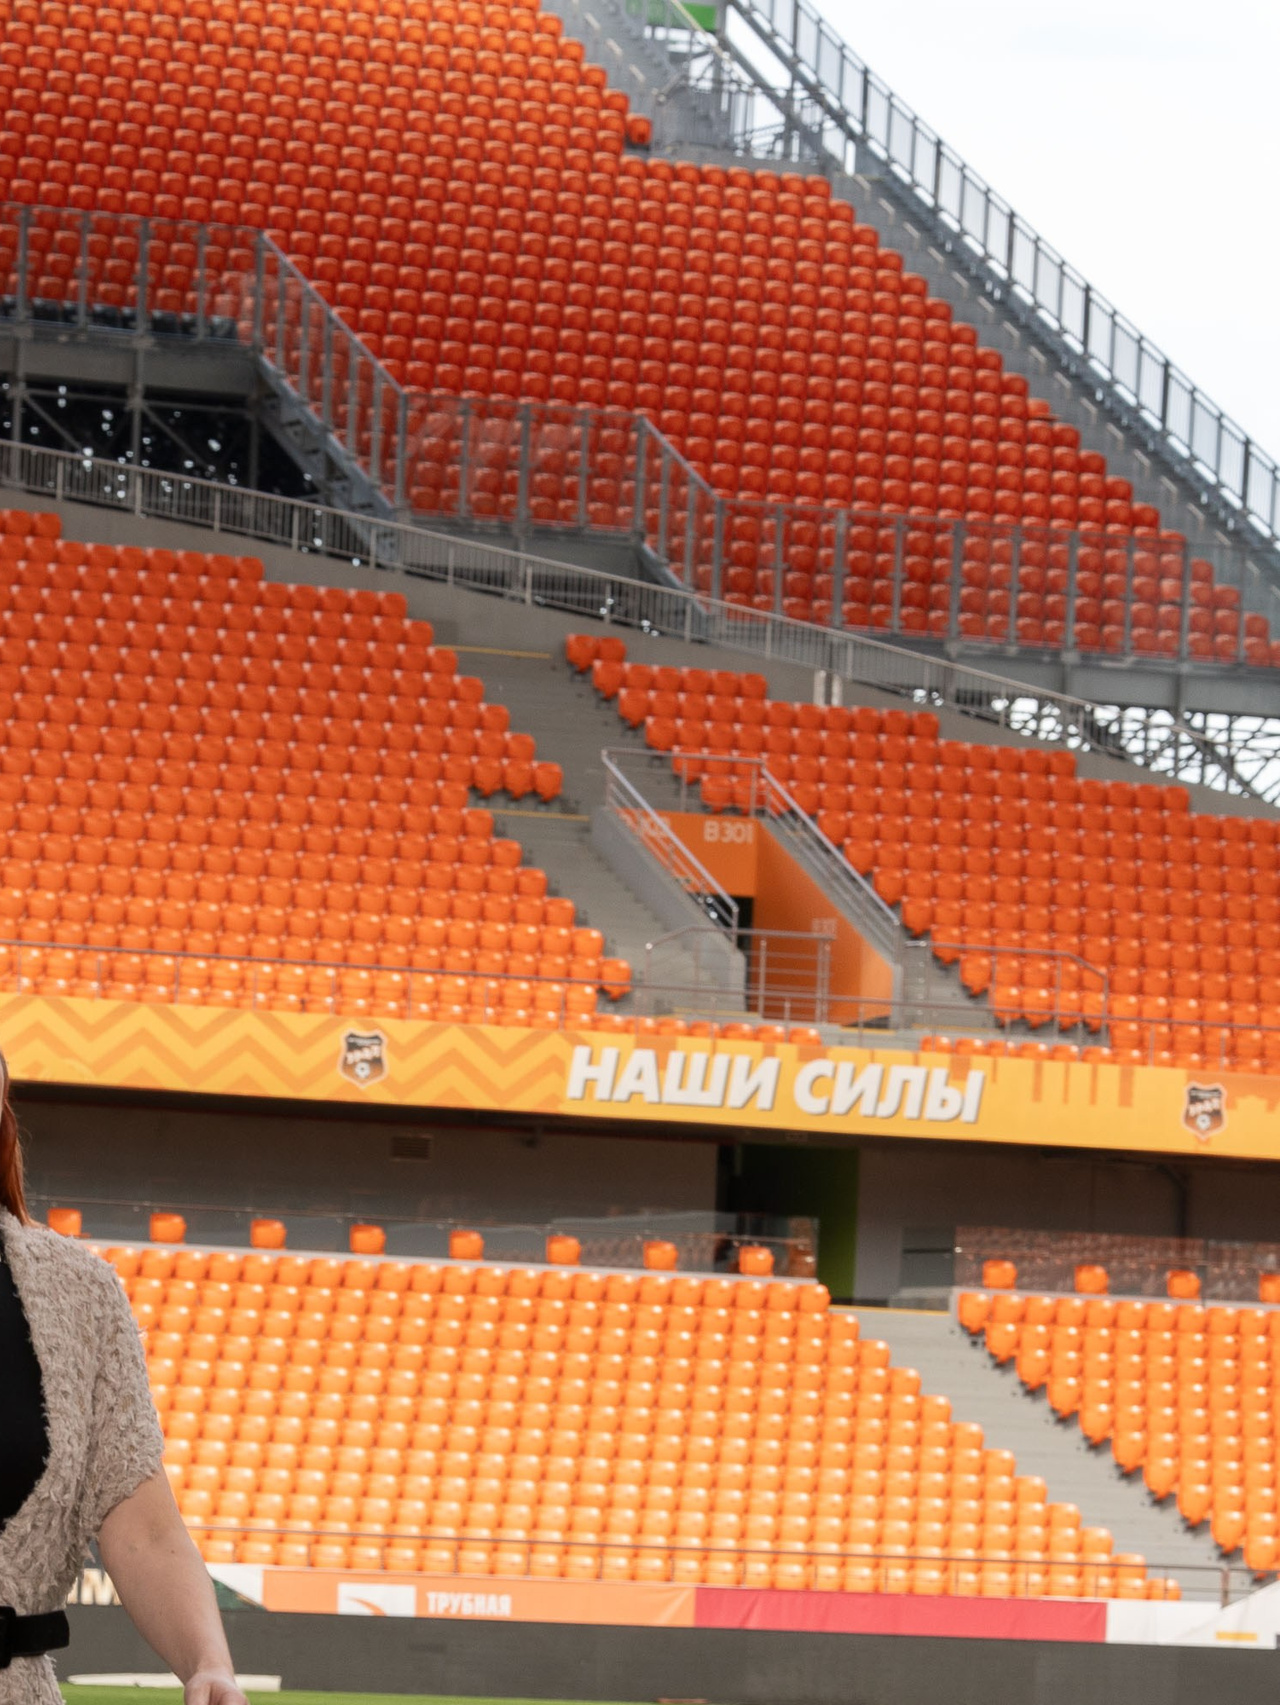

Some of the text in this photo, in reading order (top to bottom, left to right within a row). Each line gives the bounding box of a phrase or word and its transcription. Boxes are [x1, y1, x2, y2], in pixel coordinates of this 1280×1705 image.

[566, 1045, 986, 1123] НАШИ СИЛЫ
[426, 1591, 512, 1617] ТРУБНАЯ
